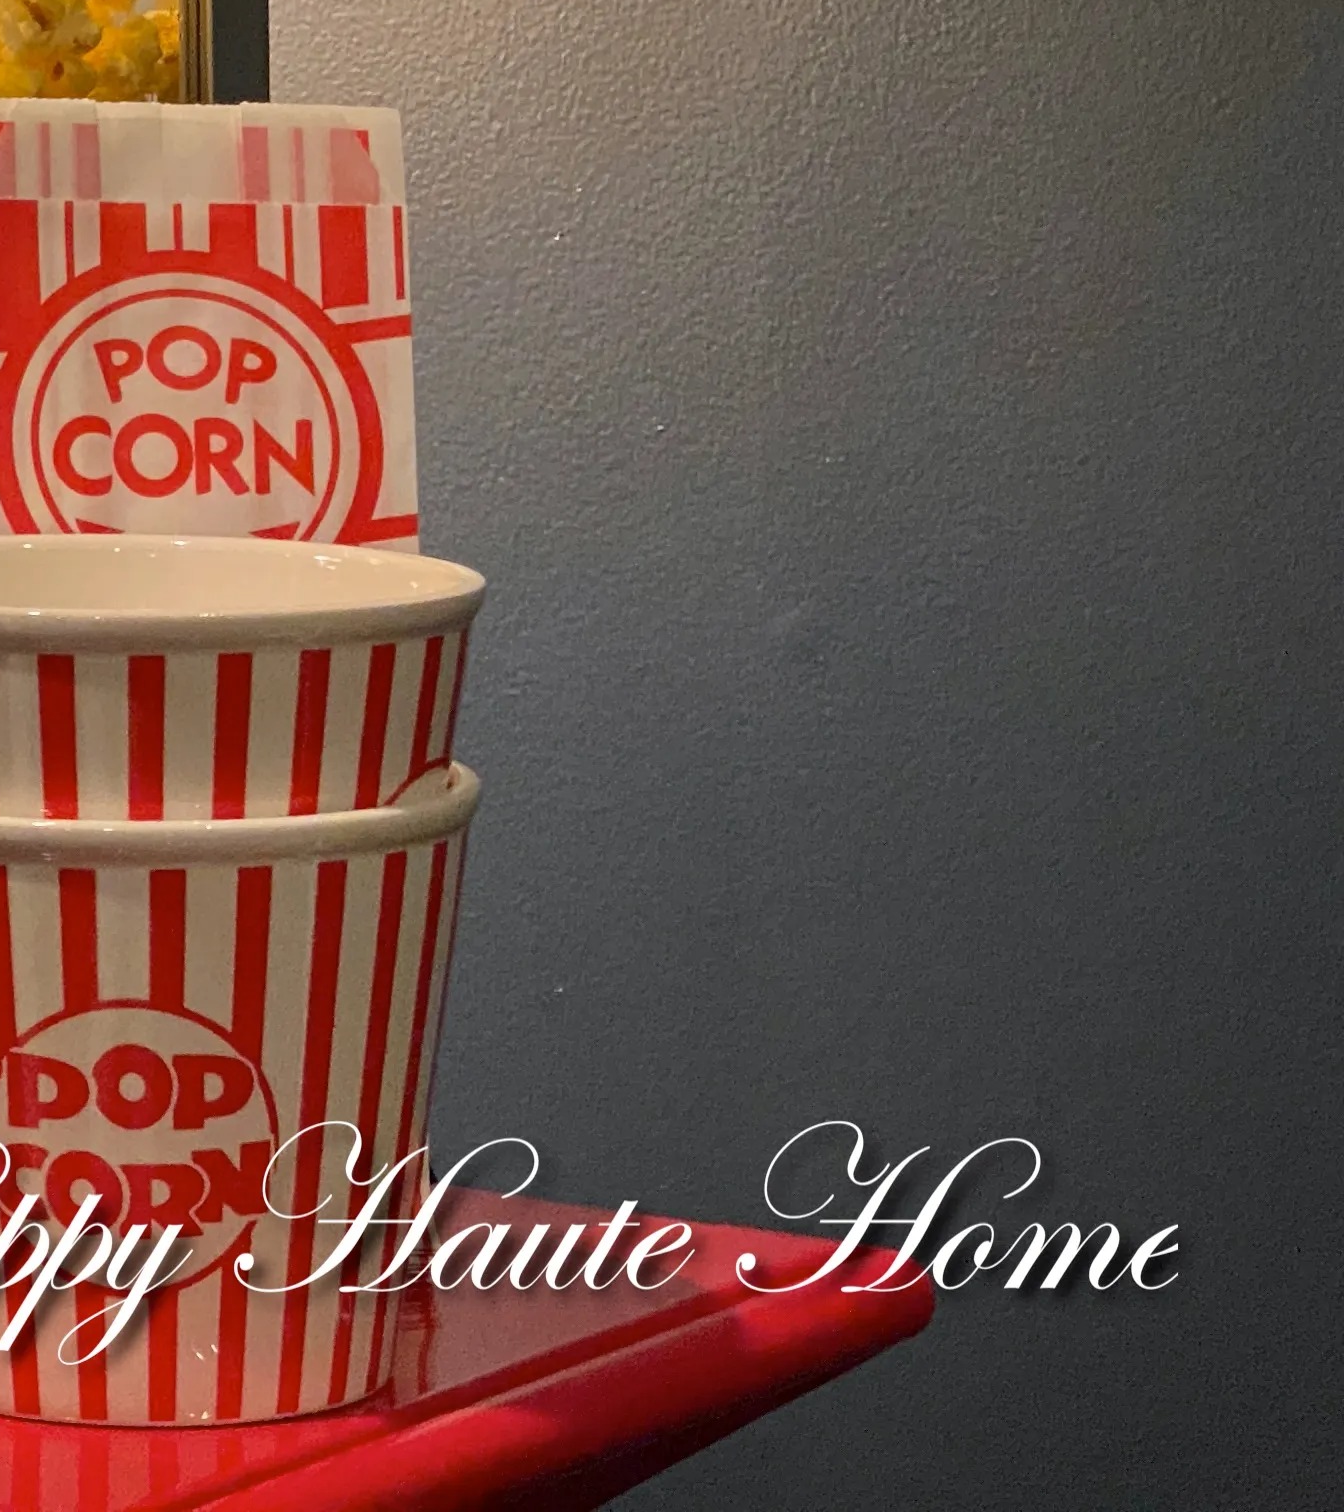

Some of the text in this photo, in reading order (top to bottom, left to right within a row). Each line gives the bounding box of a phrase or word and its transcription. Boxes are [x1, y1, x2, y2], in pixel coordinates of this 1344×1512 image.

[93, 325, 278, 405] POP
[53, 413, 316, 498] CORN
[7, 1044, 255, 1130] POP
